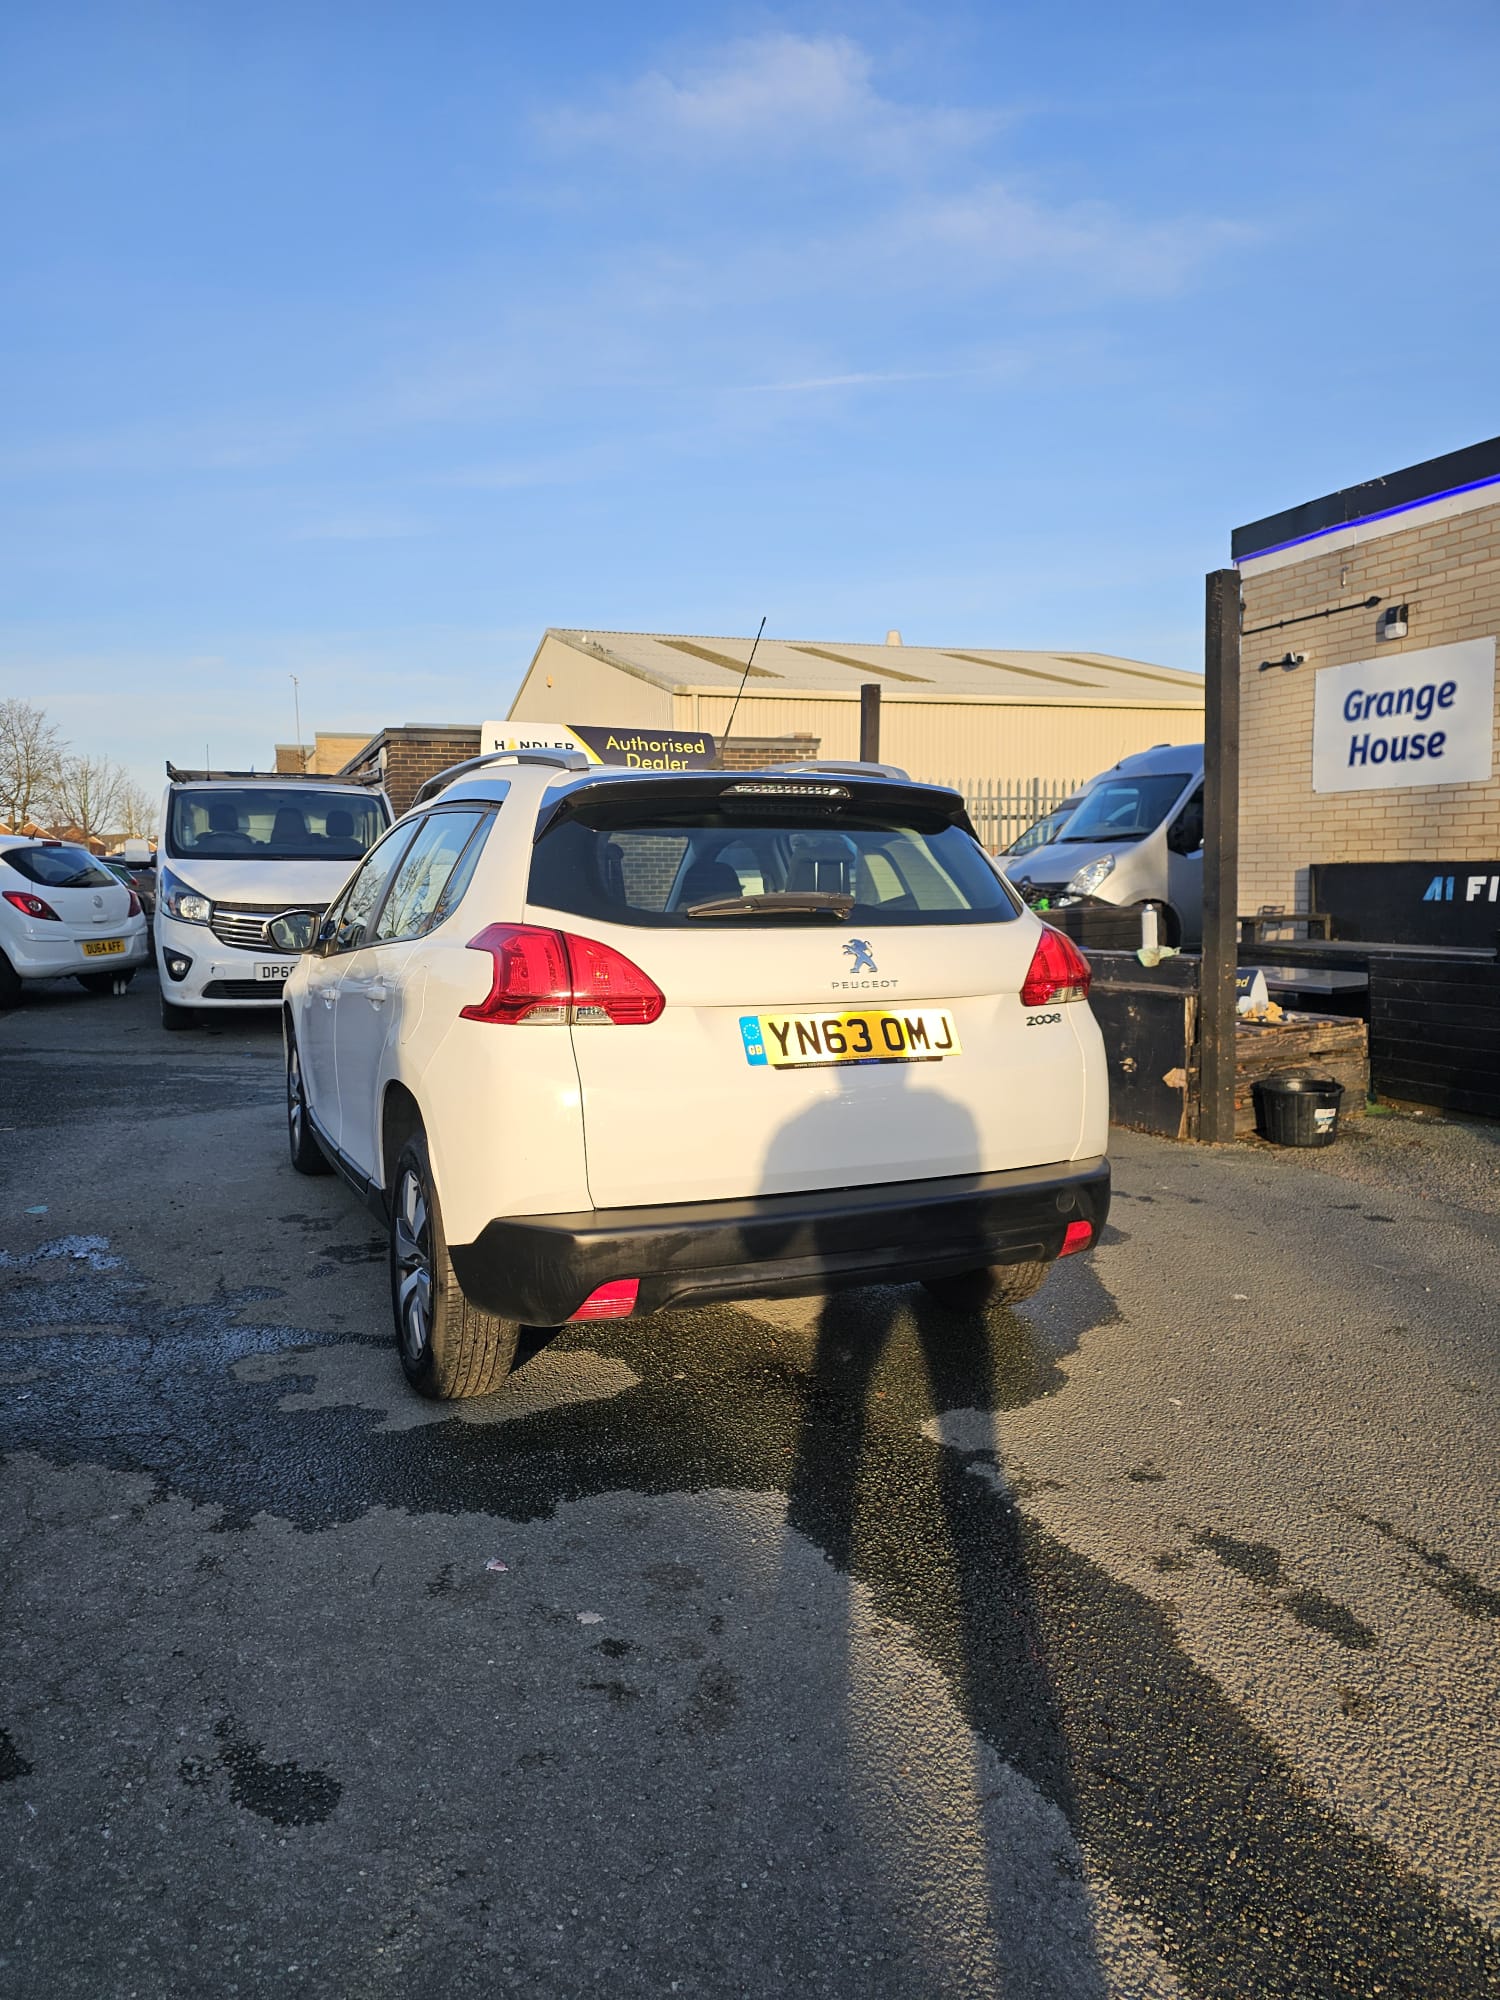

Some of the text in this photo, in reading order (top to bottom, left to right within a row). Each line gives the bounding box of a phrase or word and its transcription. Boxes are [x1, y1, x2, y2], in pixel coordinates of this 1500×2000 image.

[1343, 680, 1457, 722] Grange
[606, 735, 706, 754] Authorised
[1348, 731, 1447, 767] House
[626, 753, 689, 770] Dealer
[831, 979, 899, 990] PEUGEOT
[1025, 1012, 1062, 1027] 2008
[767, 1016, 953, 1057] YN63 OMJ
